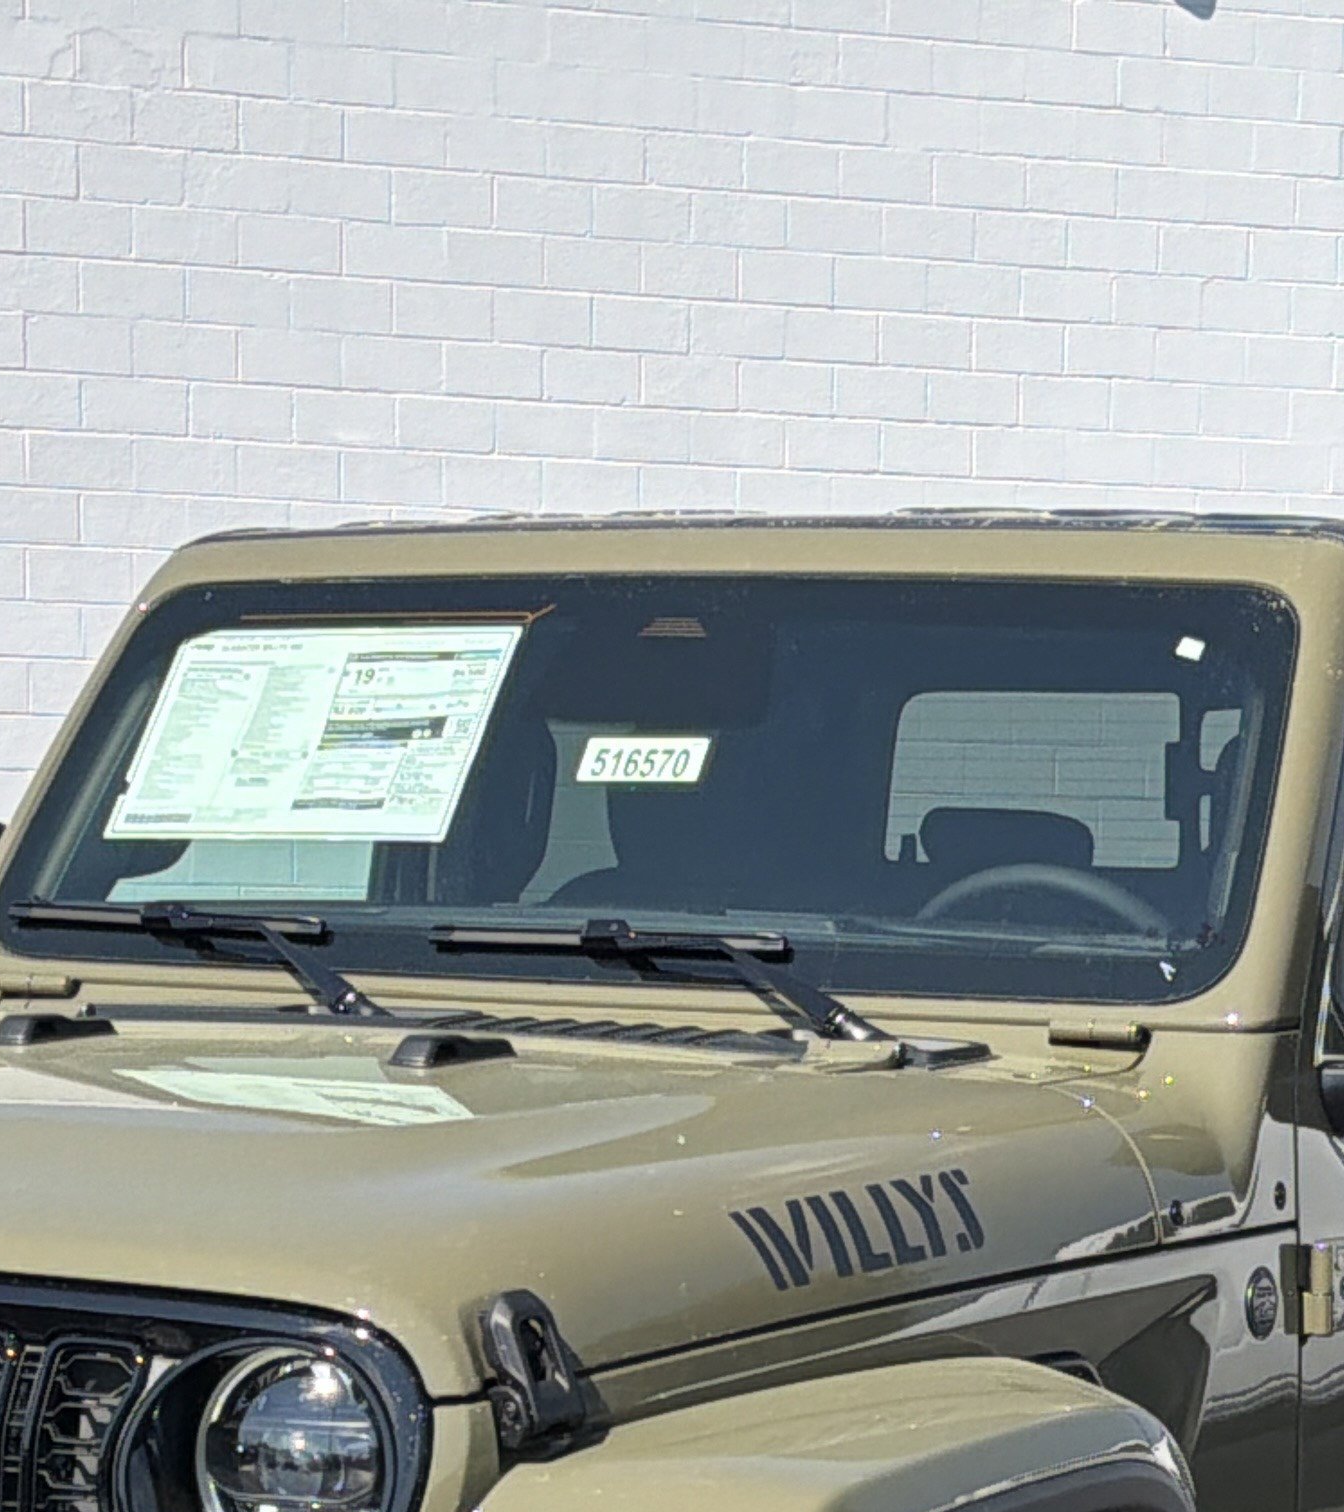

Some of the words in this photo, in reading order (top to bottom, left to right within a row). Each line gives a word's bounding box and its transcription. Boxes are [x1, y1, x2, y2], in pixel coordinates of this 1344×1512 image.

[354, 666, 376, 686] 19
[590, 748, 690, 778] 516570
[728, 1168, 985, 1291] WILLYS
